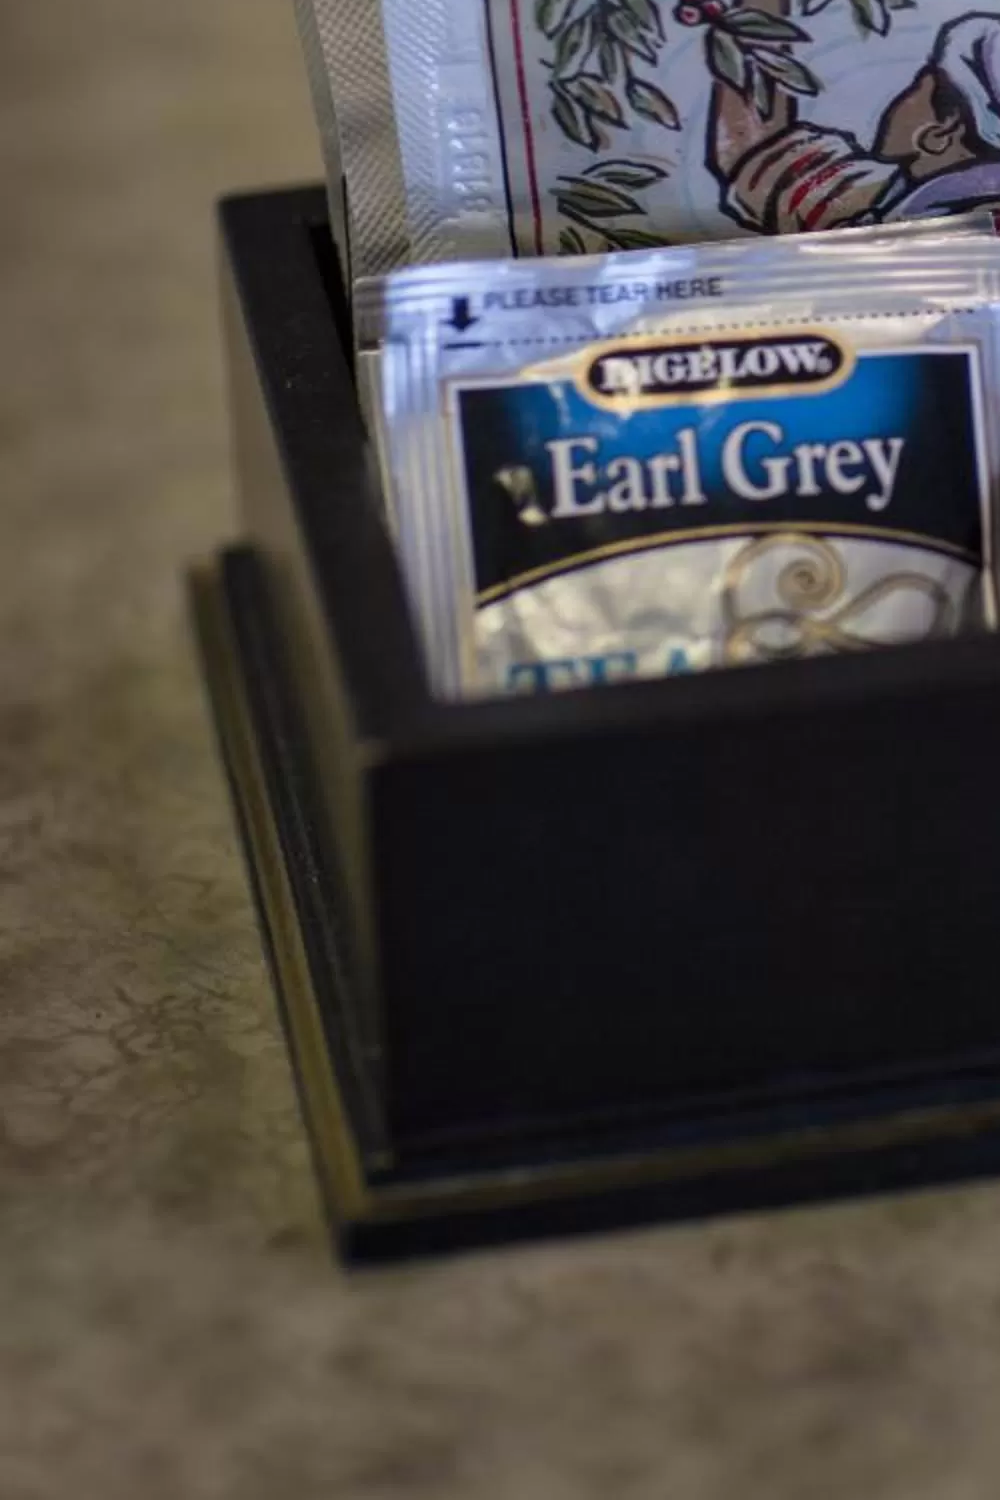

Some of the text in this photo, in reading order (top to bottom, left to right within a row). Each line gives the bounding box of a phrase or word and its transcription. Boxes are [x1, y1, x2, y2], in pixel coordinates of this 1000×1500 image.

[483, 277, 724, 310] PLEASE TEAR HERE
[545, 420, 906, 518] Earl Grey
